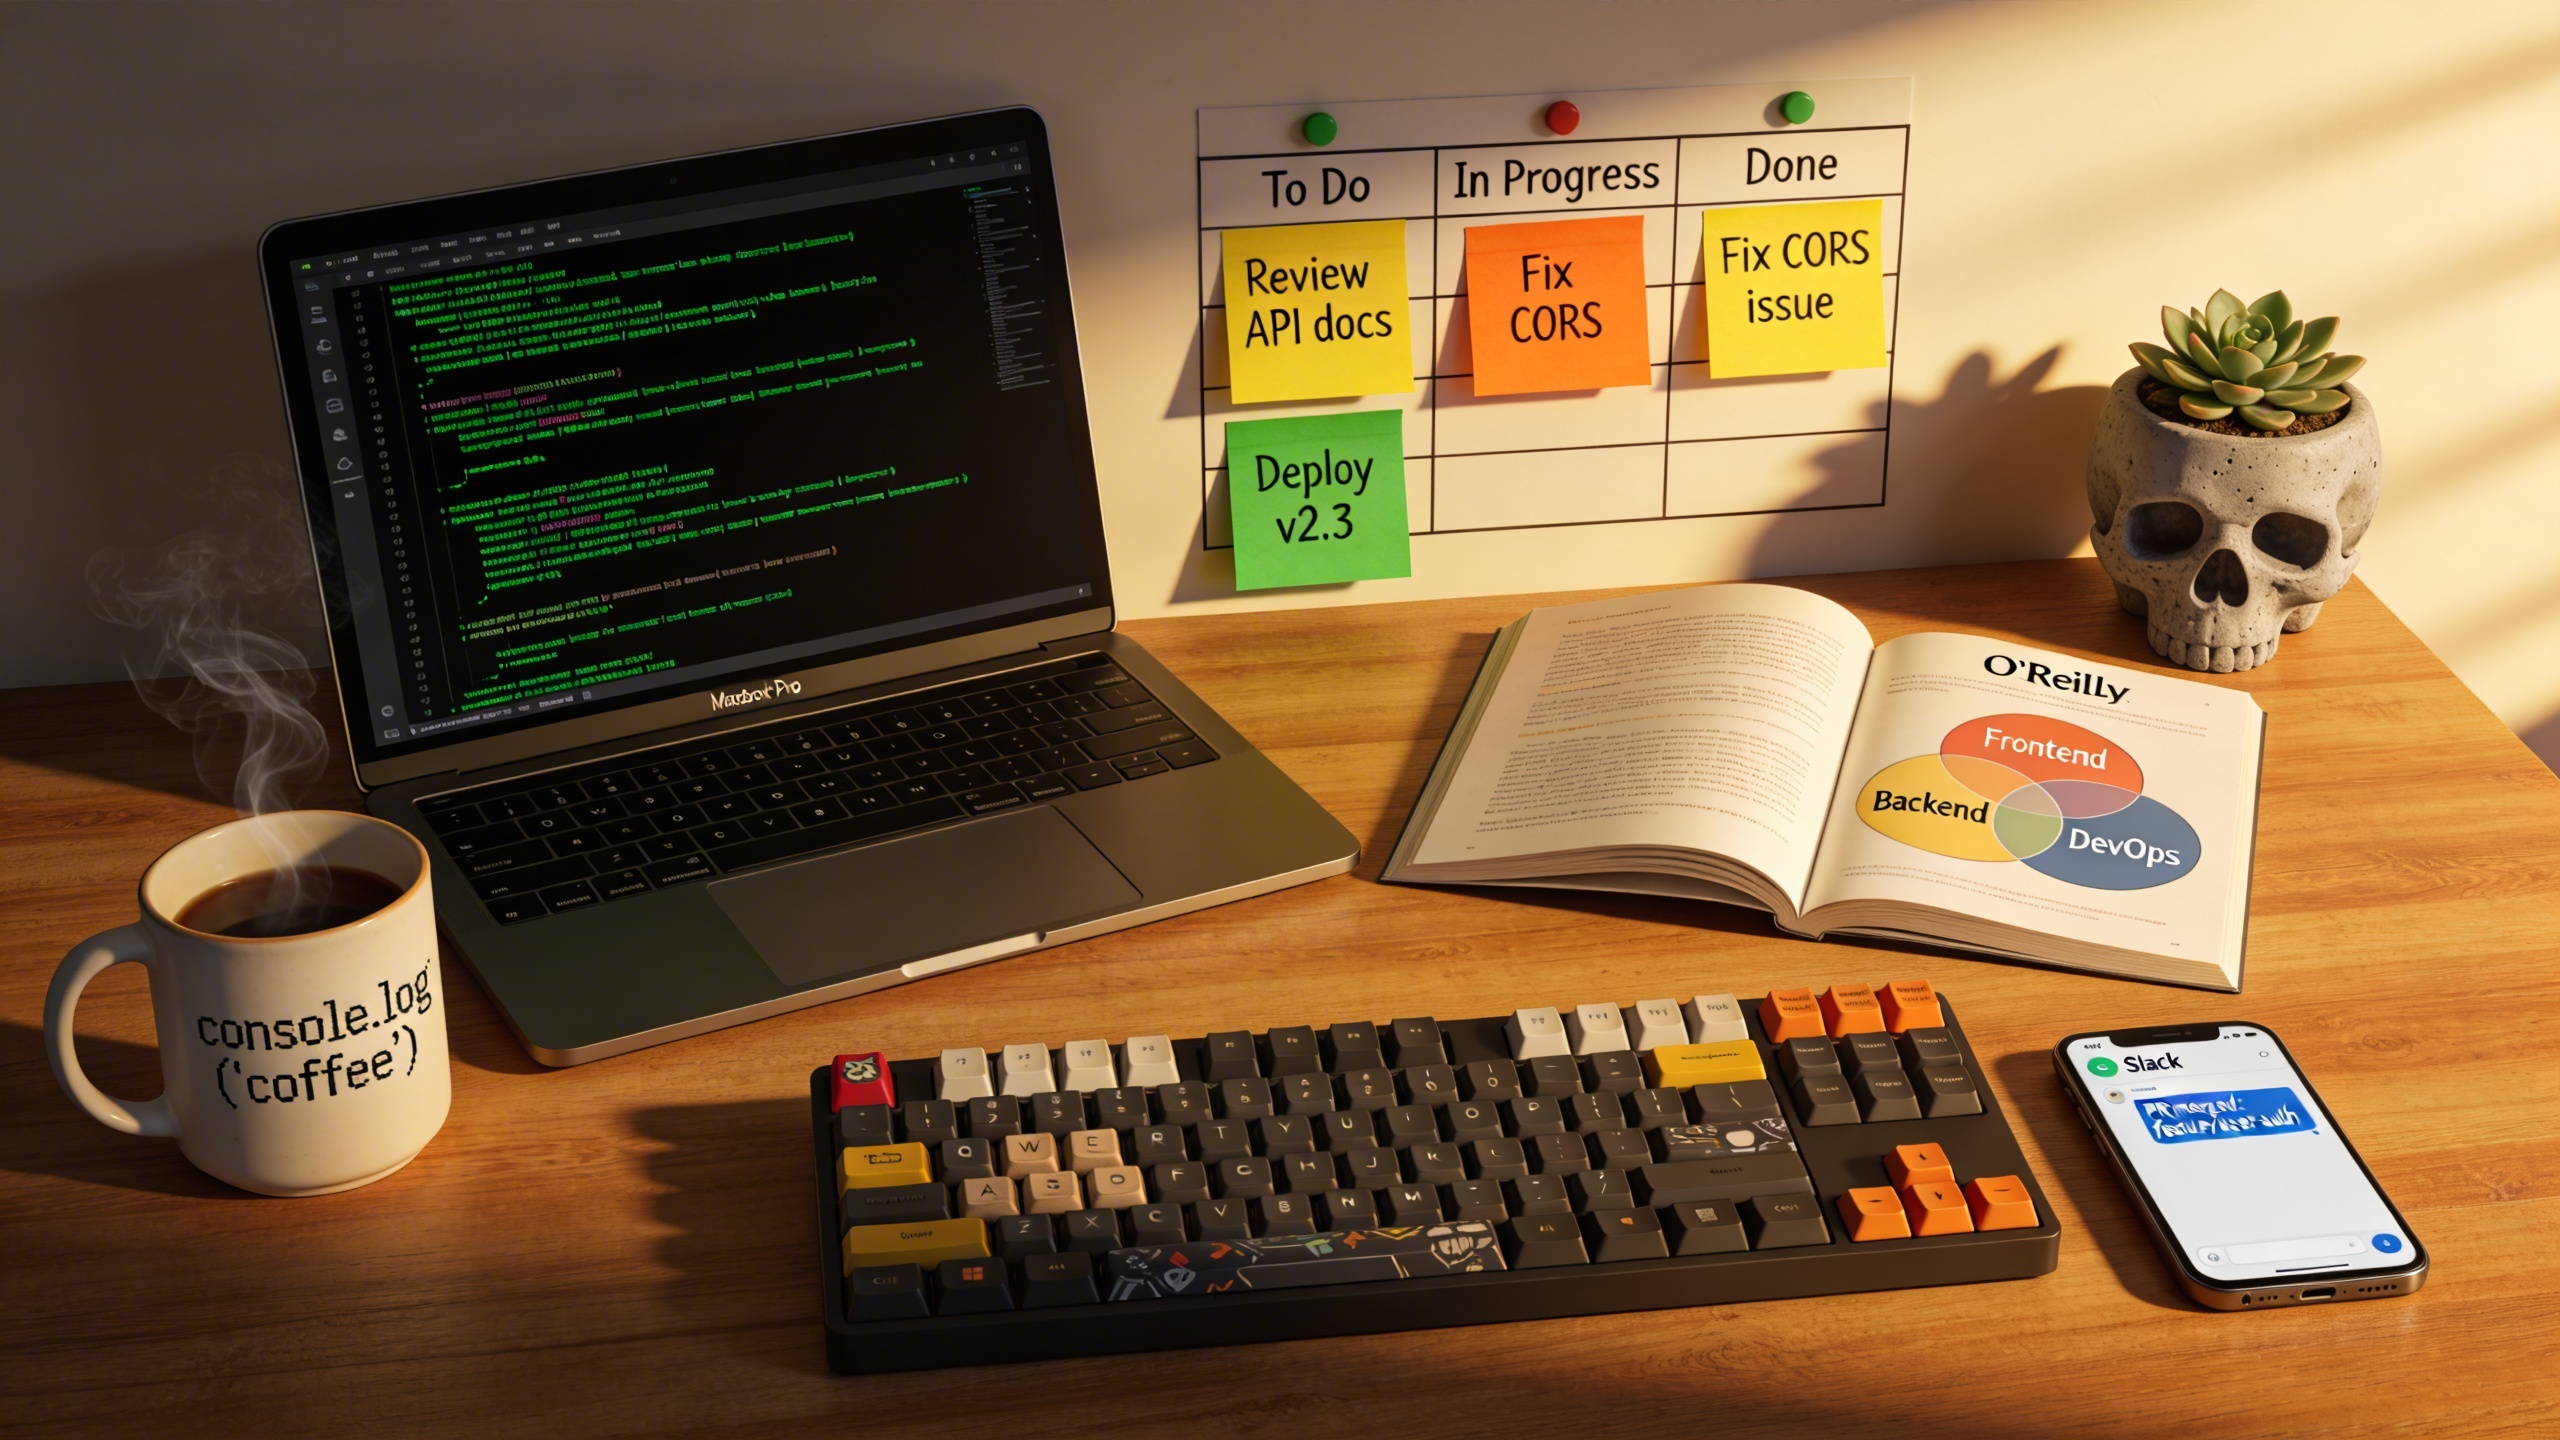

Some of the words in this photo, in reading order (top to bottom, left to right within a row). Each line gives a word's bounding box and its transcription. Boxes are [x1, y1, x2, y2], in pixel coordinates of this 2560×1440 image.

[1261, 169, 1307, 208] To
[1321, 167, 1370, 205] Do
[1454, 161, 1489, 199] In
[1504, 158, 1661, 202] Progress
[1745, 147, 1838, 186] Done
[1720, 236, 1771, 274] Fix
[1782, 229, 1871, 269] CORS
[1244, 256, 1370, 297] Review
[1521, 253, 1574, 293] Fix
[1245, 307, 1301, 349] API
[1314, 302, 1393, 343] docs
[1510, 301, 1603, 343] CORS
[1747, 289, 1834, 324] issue
[1255, 448, 1374, 499] Deploy
[1275, 502, 1354, 545] v2.3
[1983, 654, 2131, 705] O'Reilly
[1984, 726, 2108, 771] Frontend
[1872, 789, 1990, 825] Backend
[2068, 827, 2181, 869] DevOps
[198, 960, 432, 1051] console.log
[2123, 1052, 2184, 1073] Slack
[1018, 1139, 1041, 1153] W
[1212, 1125, 1229, 1140] T
[1278, 1120, 1294, 1133] Y
[1341, 1116, 1354, 1130] U
[1465, 1107, 1480, 1119] O
[980, 1183, 998, 1197] A
[1365, 1155, 1378, 1168] J
[1083, 1215, 1100, 1229] X
[1148, 1209, 1166, 1223] C
[1213, 1204, 1228, 1218] V
